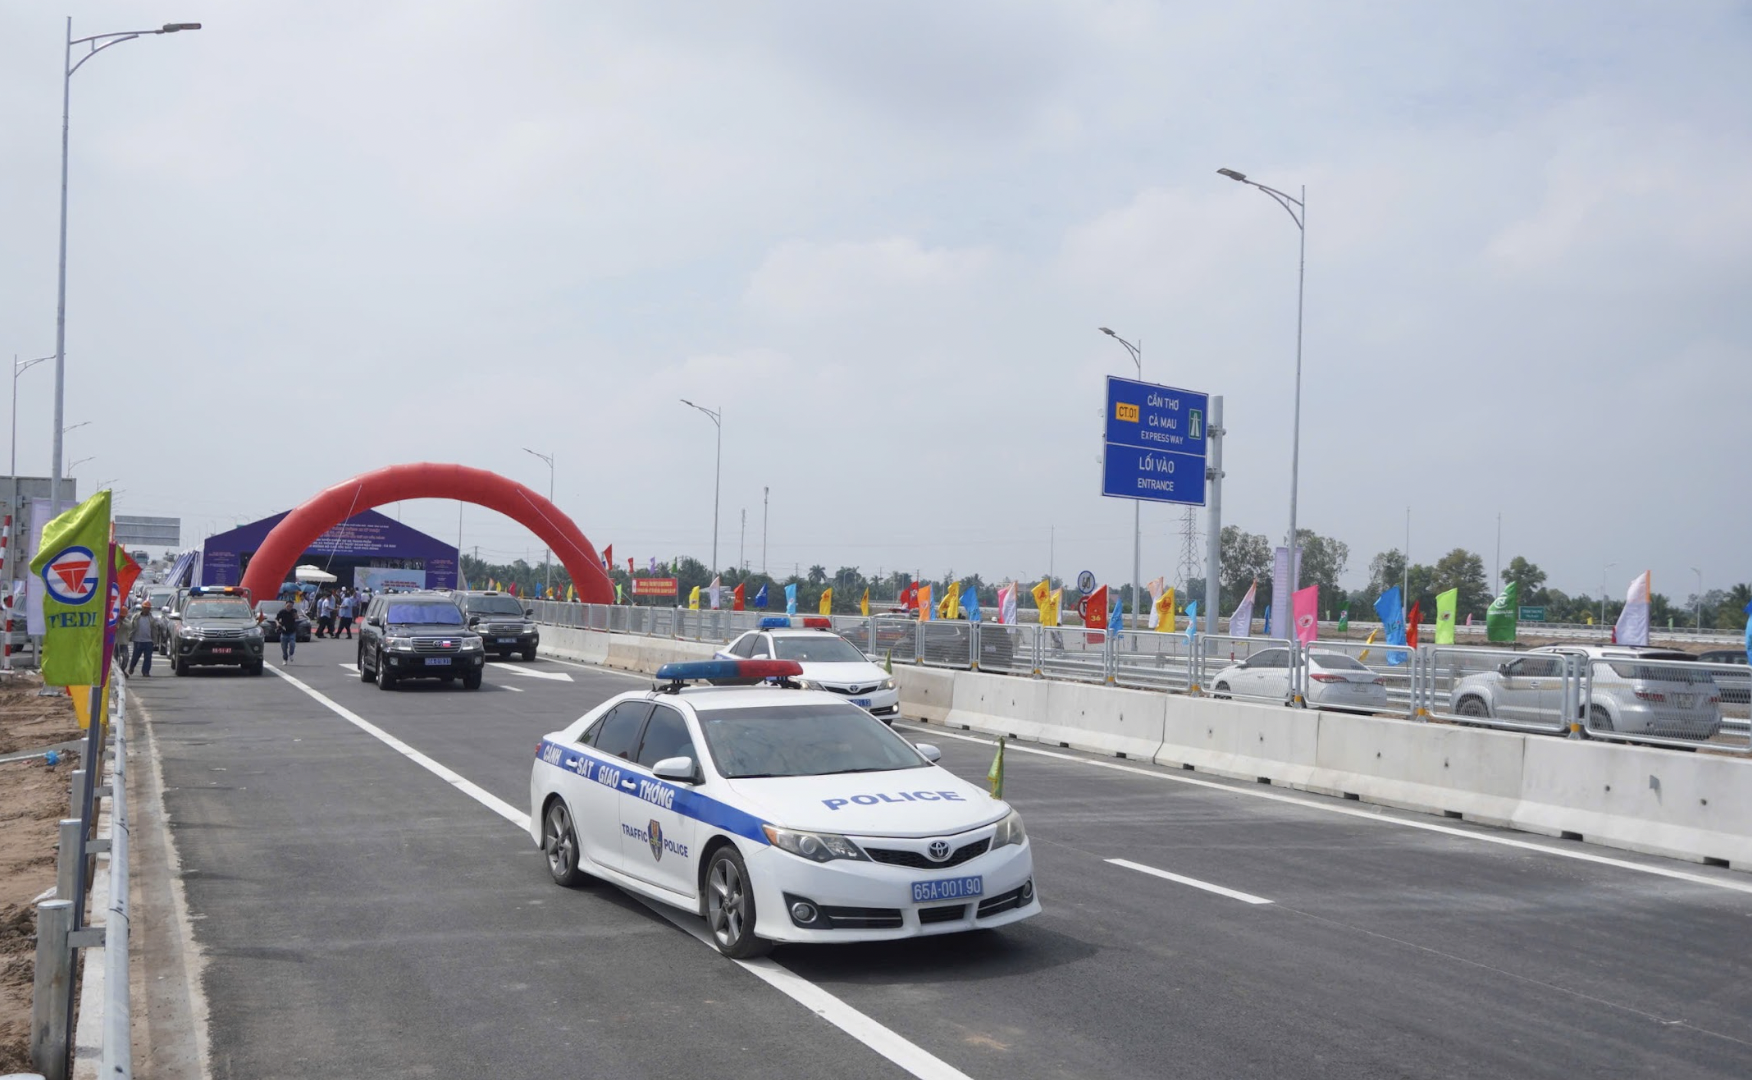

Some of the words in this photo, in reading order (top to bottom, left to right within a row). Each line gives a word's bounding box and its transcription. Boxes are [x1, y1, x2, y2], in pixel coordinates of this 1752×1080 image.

[1147, 392, 1163, 408] CẦN
[1164, 398, 1180, 411] THƠ
[1118, 406, 1137, 419] CT.01
[1148, 413, 1159, 427] CÀ
[1160, 418, 1177, 429] MAU
[1141, 431, 1183, 444] EXPRESSWAY
[1139, 453, 1154, 471] LỐI
[1156, 457, 1175, 474] VÀO
[1137, 477, 1175, 492] ENTRANCE
[47, 611, 97, 628] TEDI
[1090, 614, 1101, 622] 36
[598, 765, 620, 789] GIAO
[639, 780, 675, 810] THÔNG
[821, 791, 967, 811] POLICE
[622, 823, 648, 843] TRAFFIC
[663, 838, 689, 858] POLICE
[914, 878, 981, 900] 65A-001.90
